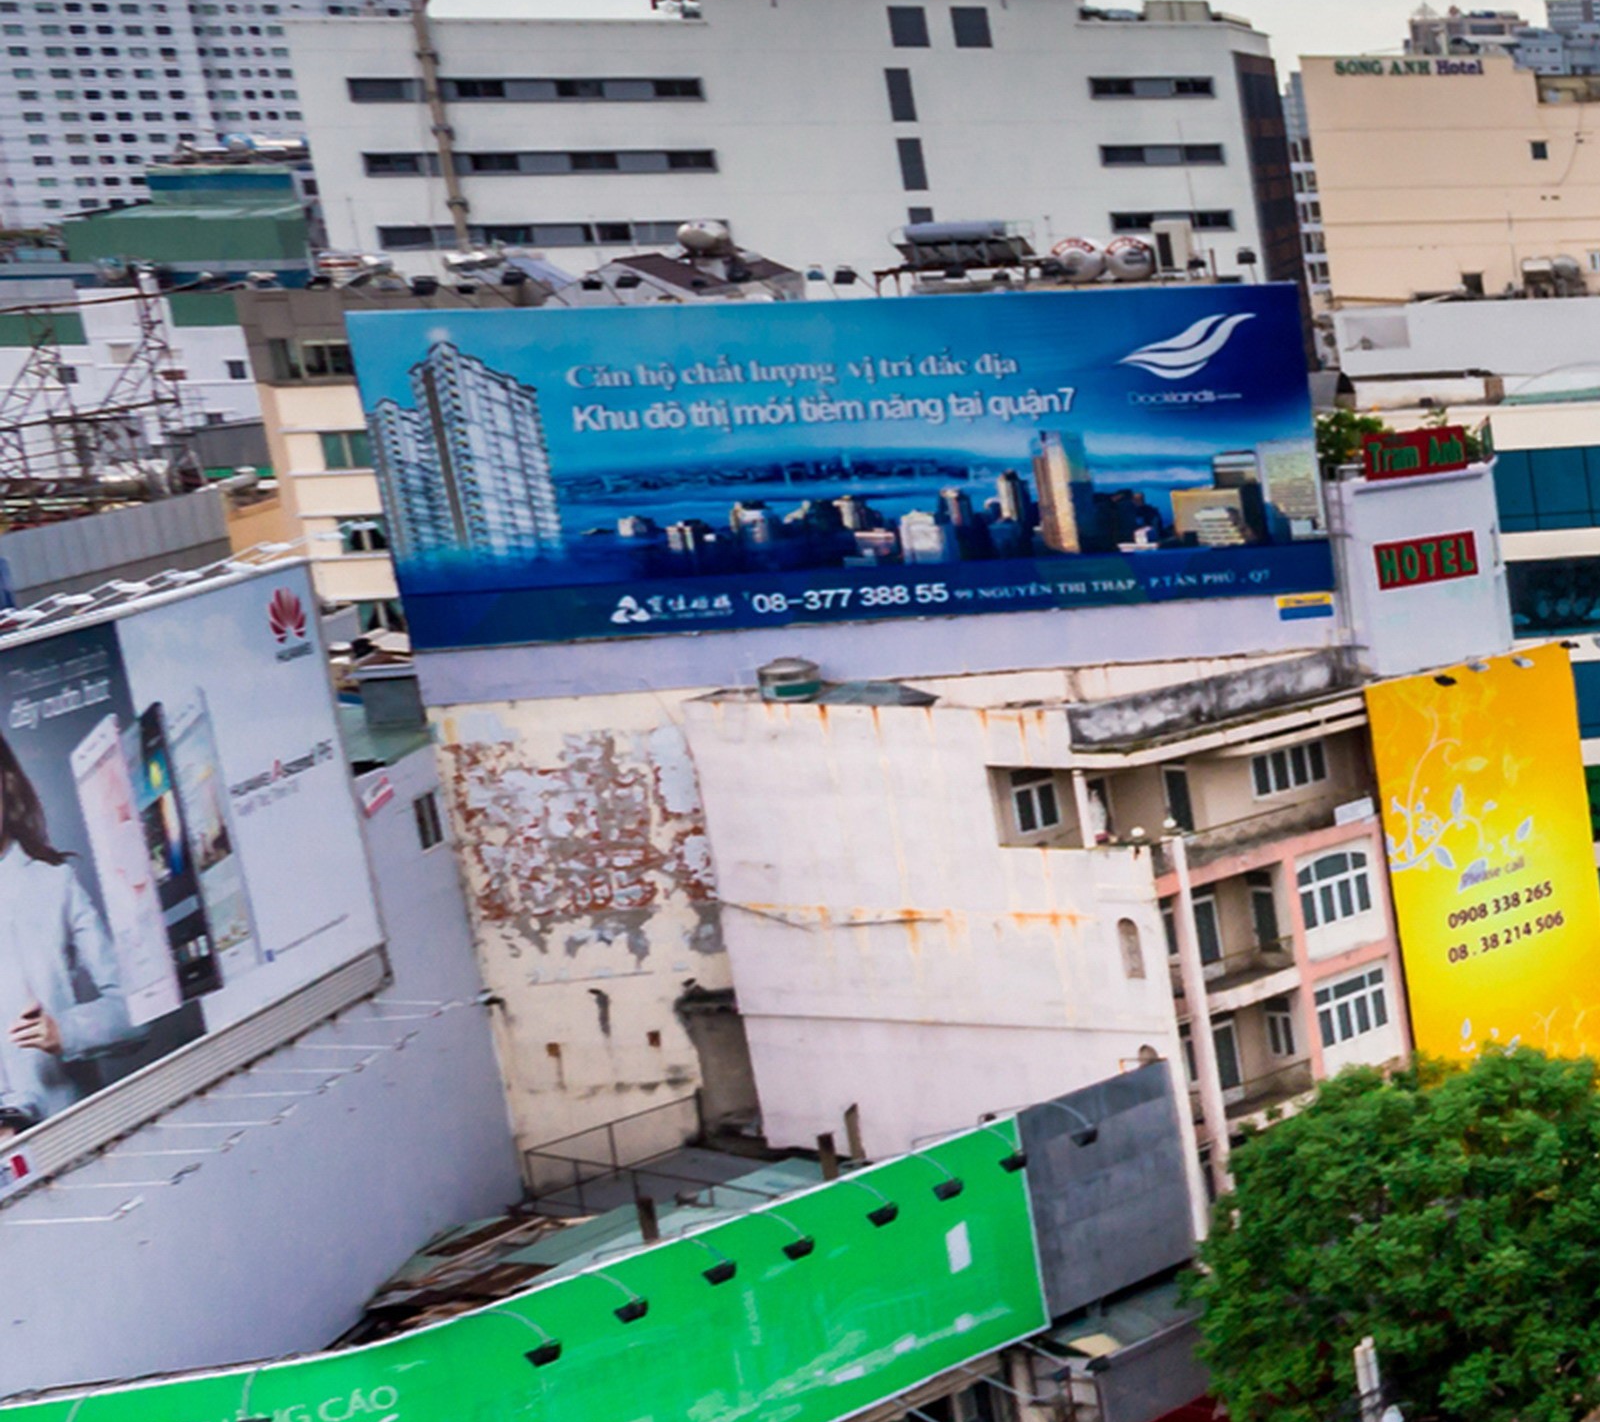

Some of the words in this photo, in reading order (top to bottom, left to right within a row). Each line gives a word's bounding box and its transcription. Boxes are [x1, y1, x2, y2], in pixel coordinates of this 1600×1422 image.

[1435, 59, 1485, 76] Hotel
[572, 402, 638, 432] Khu
[687, 398, 732, 434] thị
[735, 393, 796, 425] mới
[947, 389, 985, 423] tại
[1378, 536, 1475, 584] HOTEL
[859, 584, 911, 607] 388
[914, 582, 950, 604] 55
[1503, 854, 1525, 878] call
[1447, 902, 1489, 930] 0908
[1491, 890, 1522, 916] 338
[1524, 879, 1554, 905] 265
[1447, 943, 1469, 965] 08
[1480, 932, 1500, 955] 38
[1503, 921, 1533, 946] 214
[1535, 910, 1564, 935] 506
